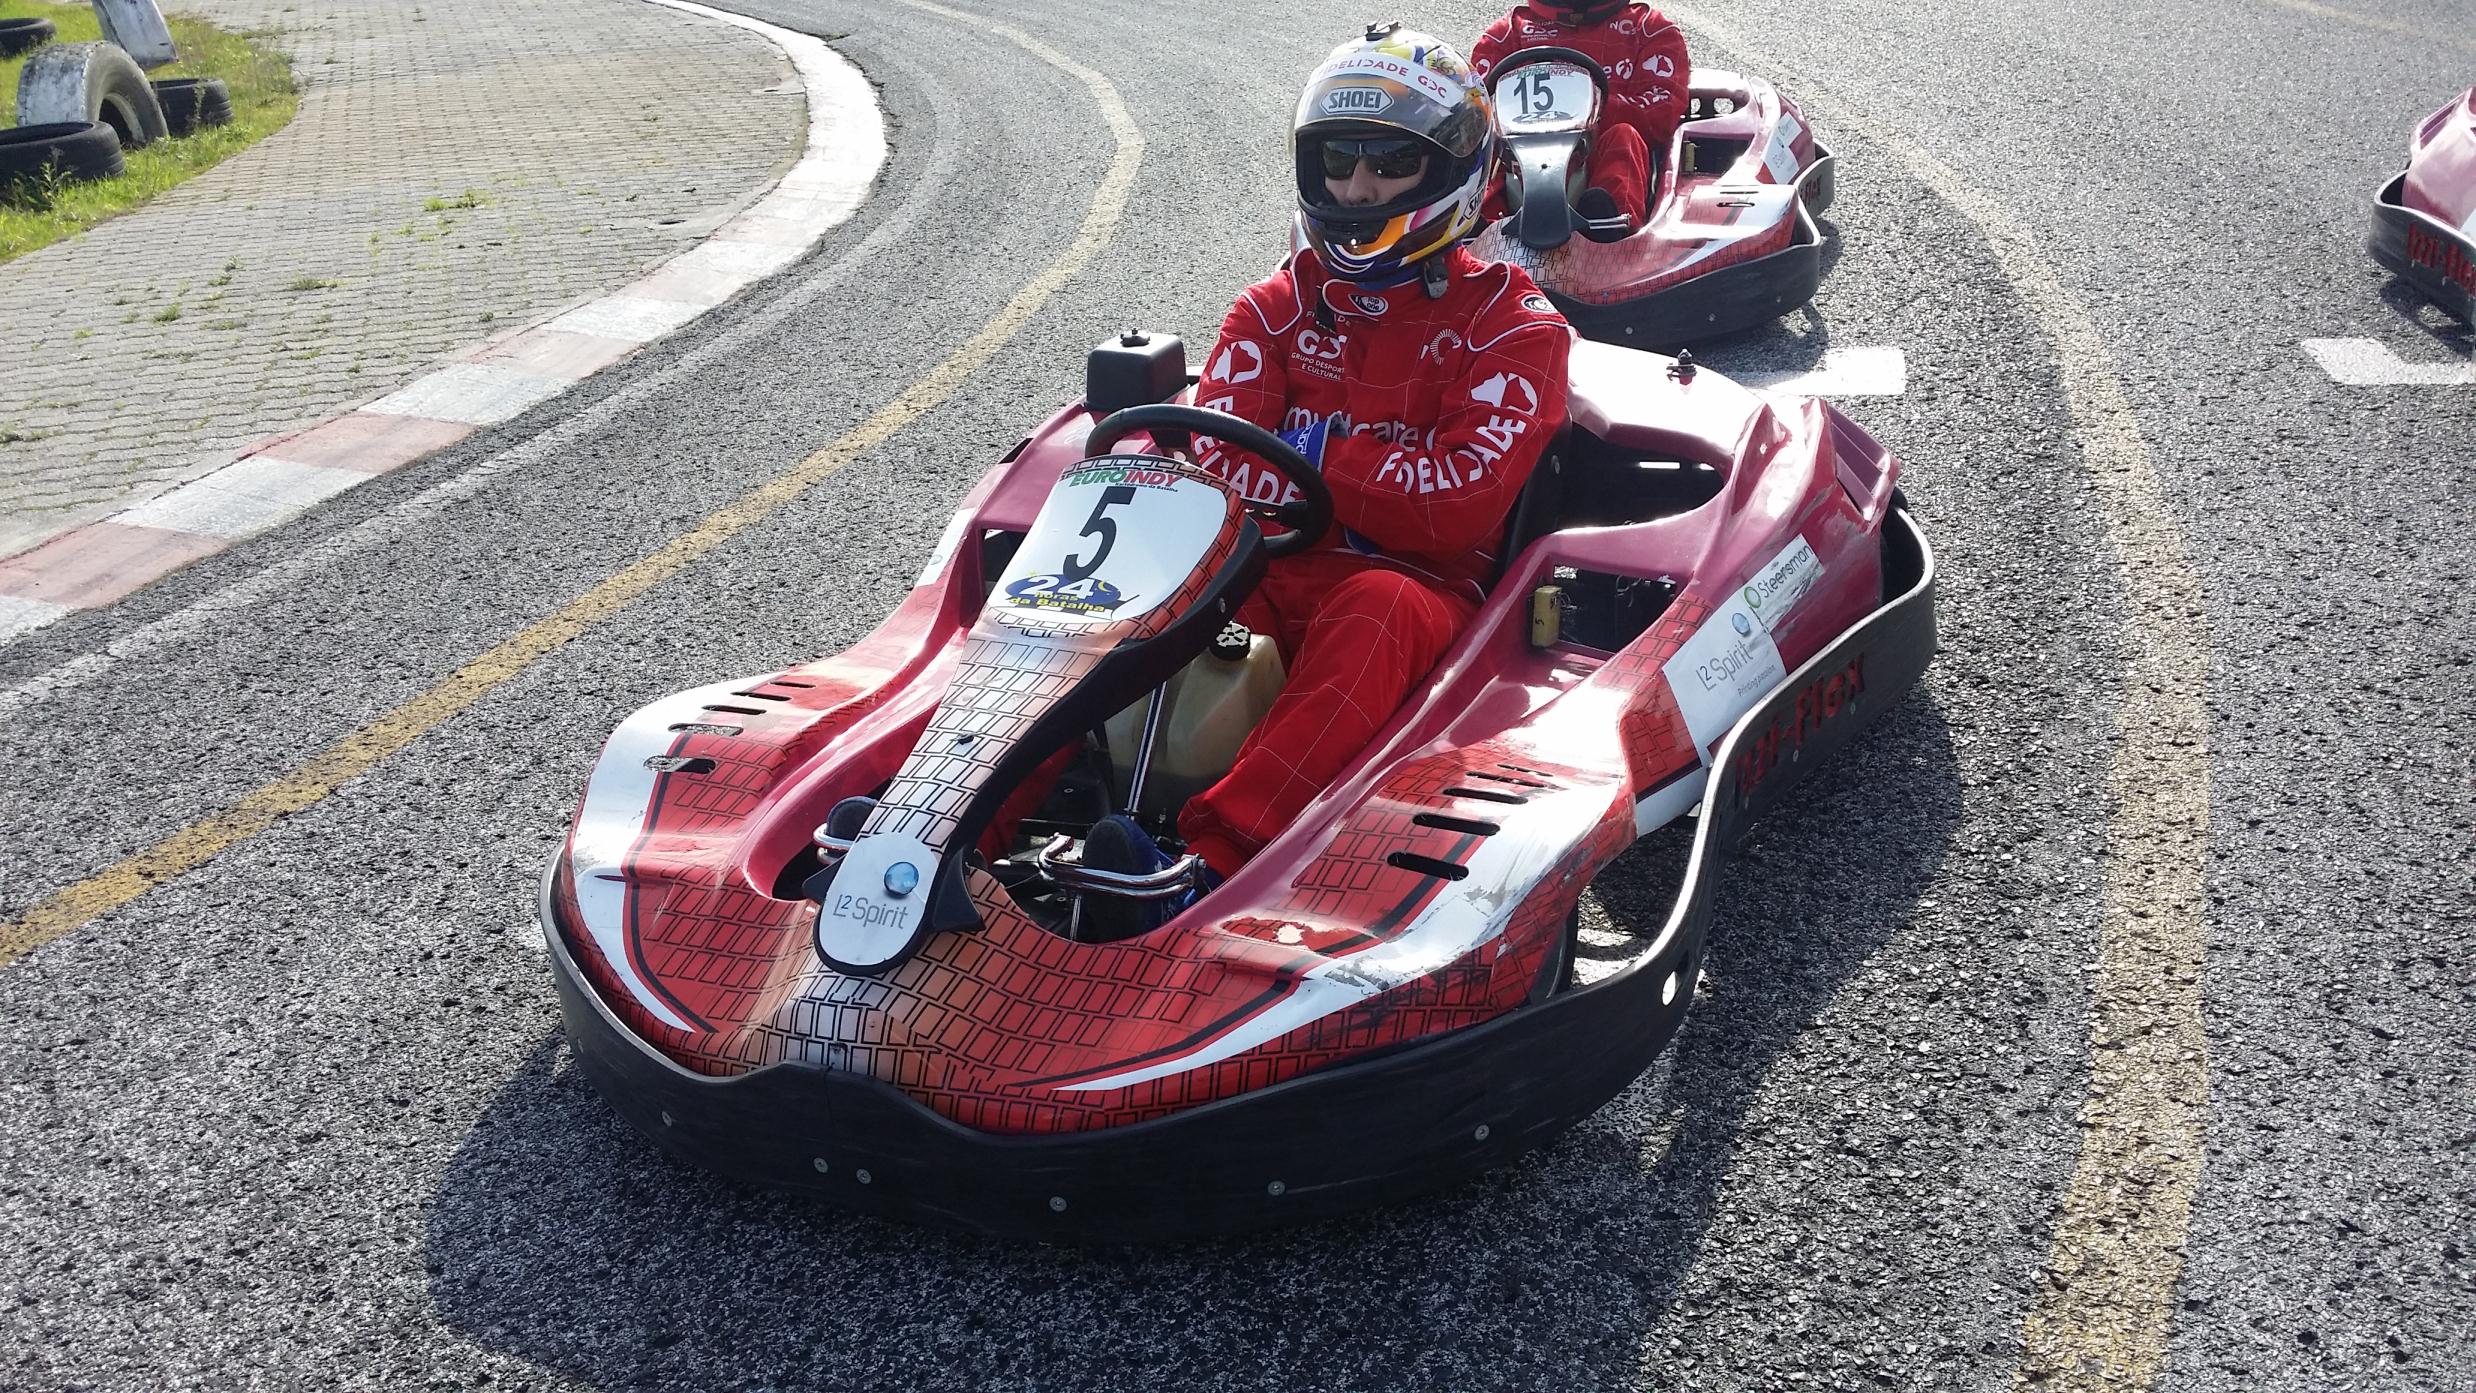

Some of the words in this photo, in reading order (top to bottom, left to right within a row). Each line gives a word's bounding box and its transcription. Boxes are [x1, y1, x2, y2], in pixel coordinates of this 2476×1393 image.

[1329, 91, 1381, 109] SHOEI
[1513, 74, 1554, 114] 15
[1291, 352, 1315, 364] GRUPO
[1315, 360, 1344, 373] DESPORT
[1307, 365, 1341, 380] CULTURAL
[1069, 470, 1183, 487] EUROINDY
[1063, 486, 1136, 581] 5
[1757, 544, 1813, 600] Steersman
[1019, 576, 1095, 600] 24
[1034, 592, 1079, 601] horas
[1009, 597, 1031, 605] da
[1036, 598, 1105, 612] Batalha
[1710, 641, 1754, 683] Spirit
[852, 897, 909, 929] Spirit
